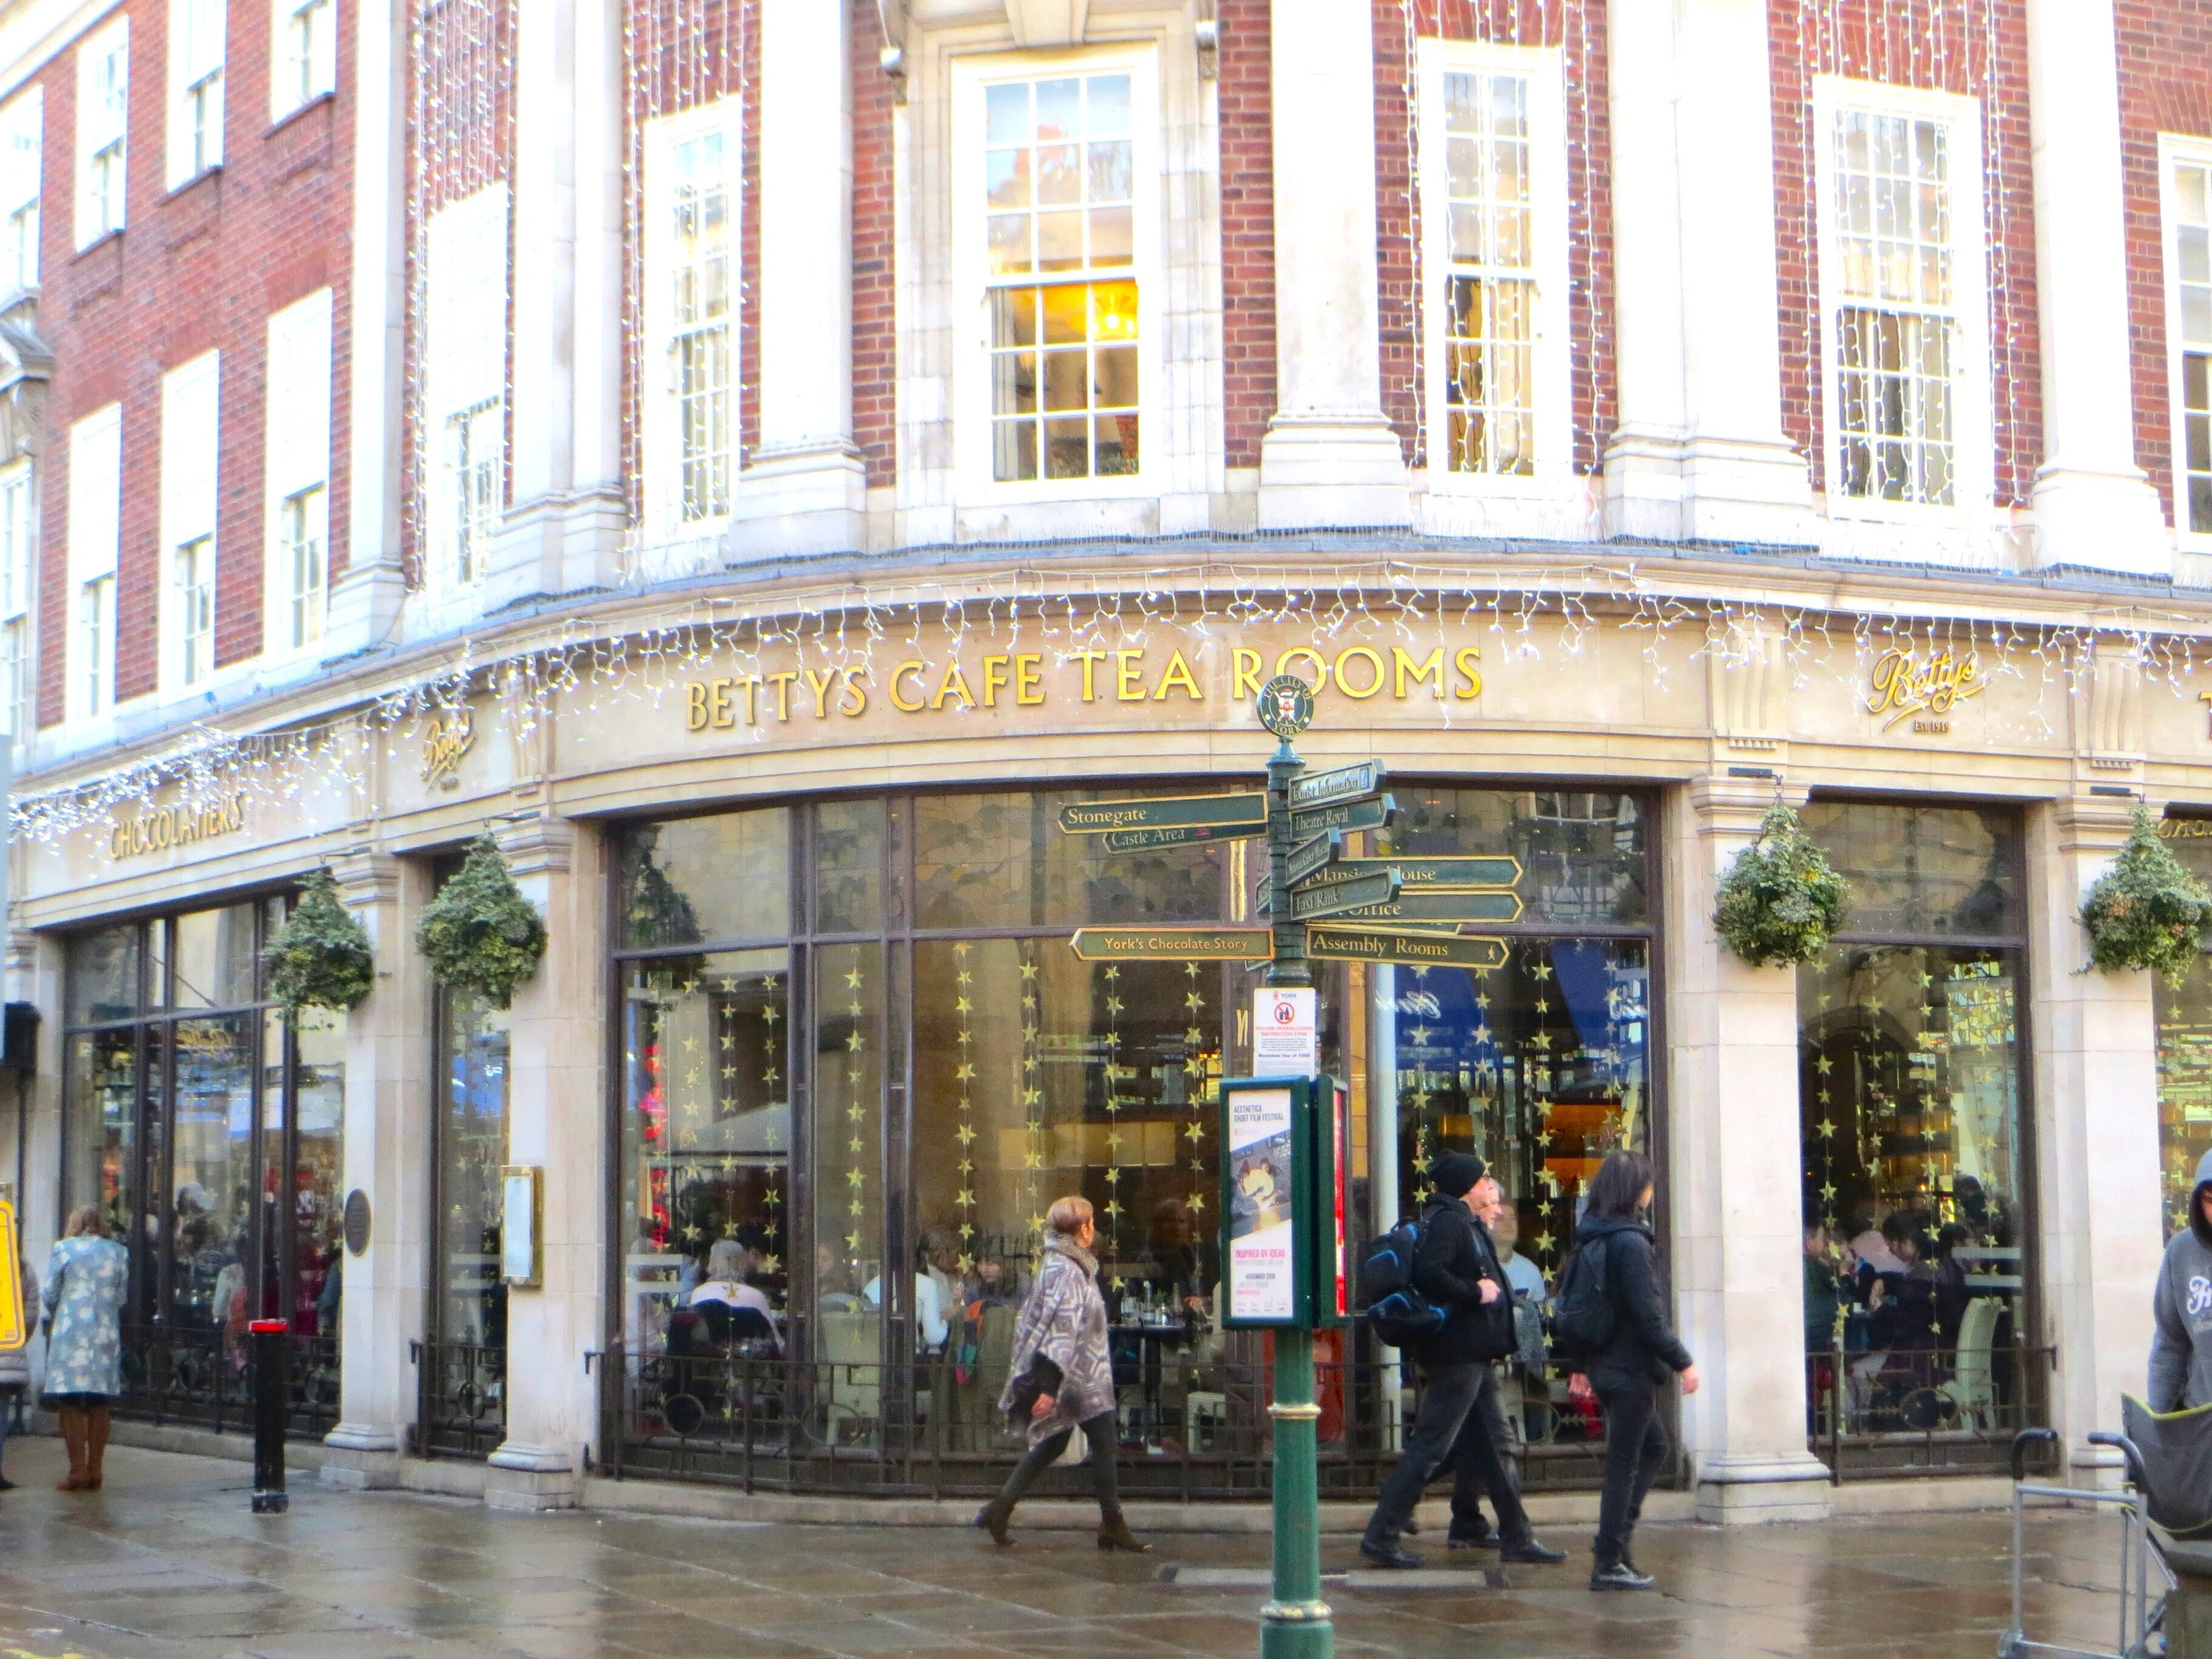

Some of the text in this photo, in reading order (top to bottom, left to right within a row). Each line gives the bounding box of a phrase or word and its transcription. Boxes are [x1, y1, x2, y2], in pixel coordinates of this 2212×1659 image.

[686, 646, 1483, 731] BETTYS CAFE TEA ROOMS
[1263, 675, 1313, 701] THE CITY OF
[1867, 649, 1991, 732] Bettys
[1274, 722, 1302, 734] YORK
[1317, 776, 1359, 797] Information
[1067, 808, 1147, 828] Stonegate
[1295, 806, 1349, 831] Theatre Royal
[1111, 828, 1185, 846] Castle Area
[1296, 889, 1339, 911] Taxi Rank
[1103, 937, 1248, 953] York's Chocolate Story
[1313, 933, 1449, 957] Assembly Rooms
[1234, 1105, 1262, 1113] AESTHETICA
[1234, 1113, 1284, 1122] SHORT FILM FESTIVAL
[1235, 1248, 1285, 1258] INSPIRED BY IDEAS
